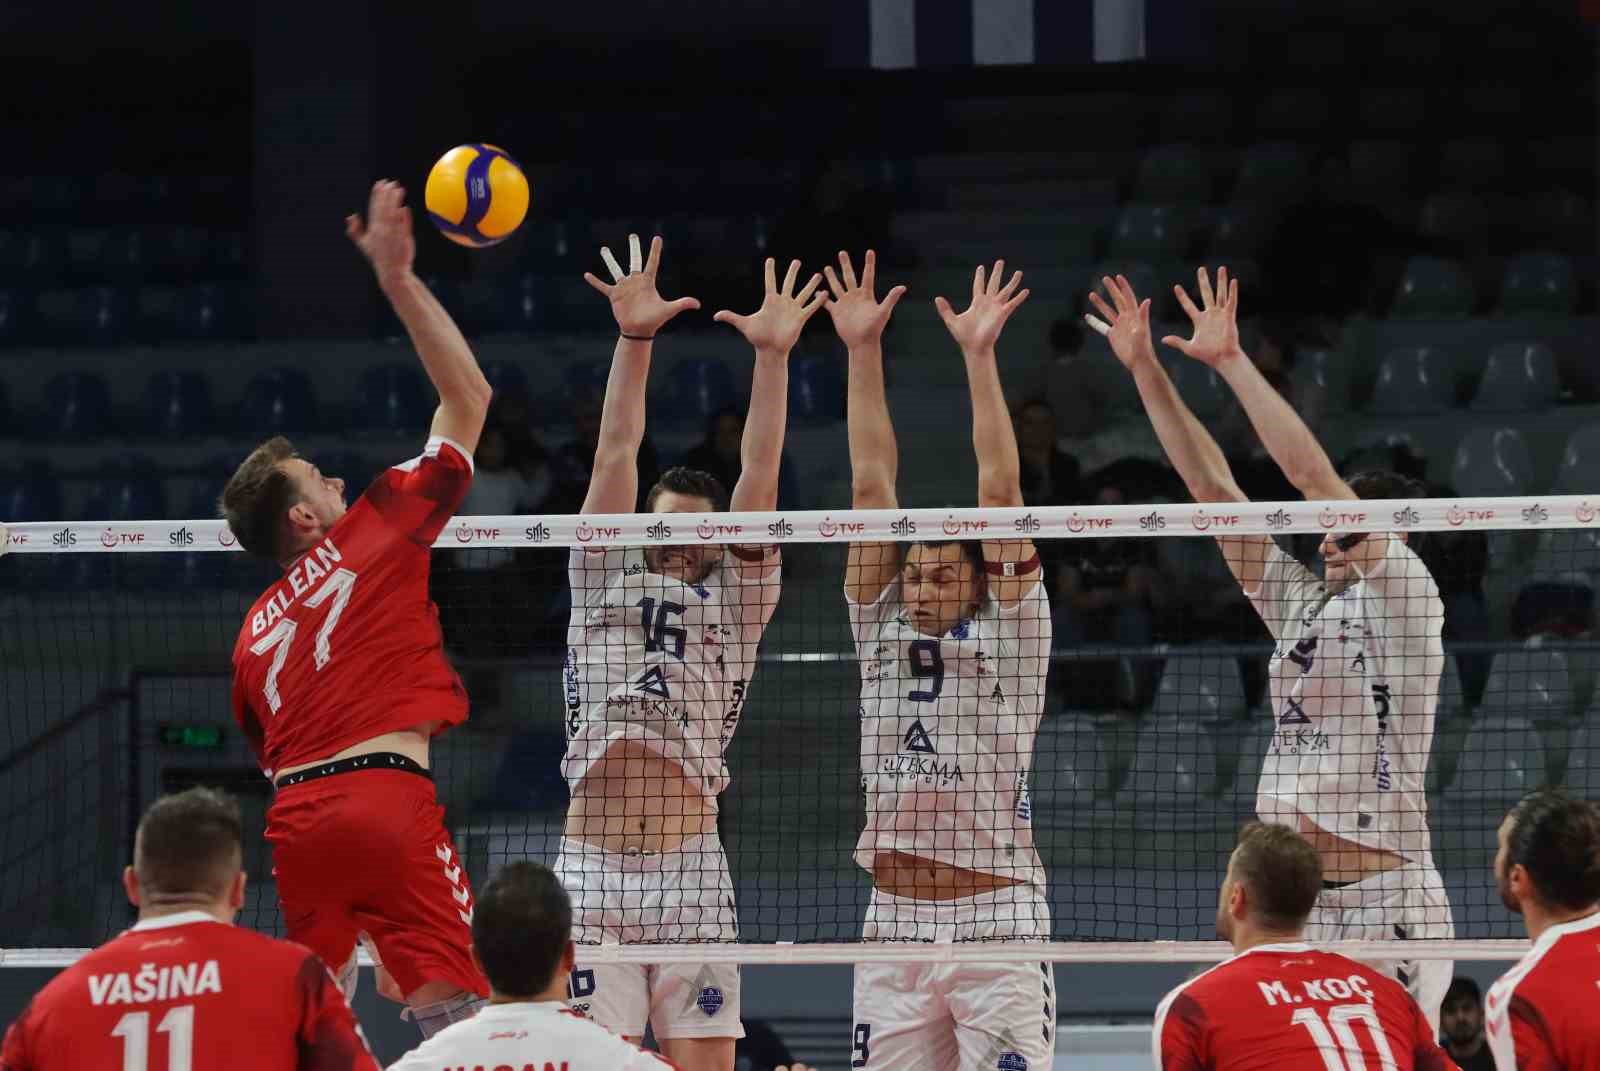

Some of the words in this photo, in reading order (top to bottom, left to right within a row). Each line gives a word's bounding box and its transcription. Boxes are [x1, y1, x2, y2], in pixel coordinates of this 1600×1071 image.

[121, 534, 145, 545] TVF
[474, 529, 500, 540] TVF
[596, 528, 620, 539] TVF
[717, 525, 742, 536] TVF
[840, 523, 865, 534] TVF
[963, 520, 988, 532] TVF
[1087, 518, 1112, 529] TVF
[1213, 515, 1240, 526] TVF
[1340, 513, 1367, 524] TVF
[1468, 511, 1495, 521] TVF
[252, 538, 342, 637] BALEAN
[250, 567, 357, 715] 77
[636, 597, 687, 661] 16
[908, 639, 945, 702] 9
[88, 959, 222, 1005] VAŠINA
[1257, 980, 1302, 1006] M.
[1303, 975, 1374, 1004] KOÇ
[110, 1004, 195, 1071] 11
[851, 1023, 871, 1067] 9
[1290, 1003, 1398, 1071] 10
